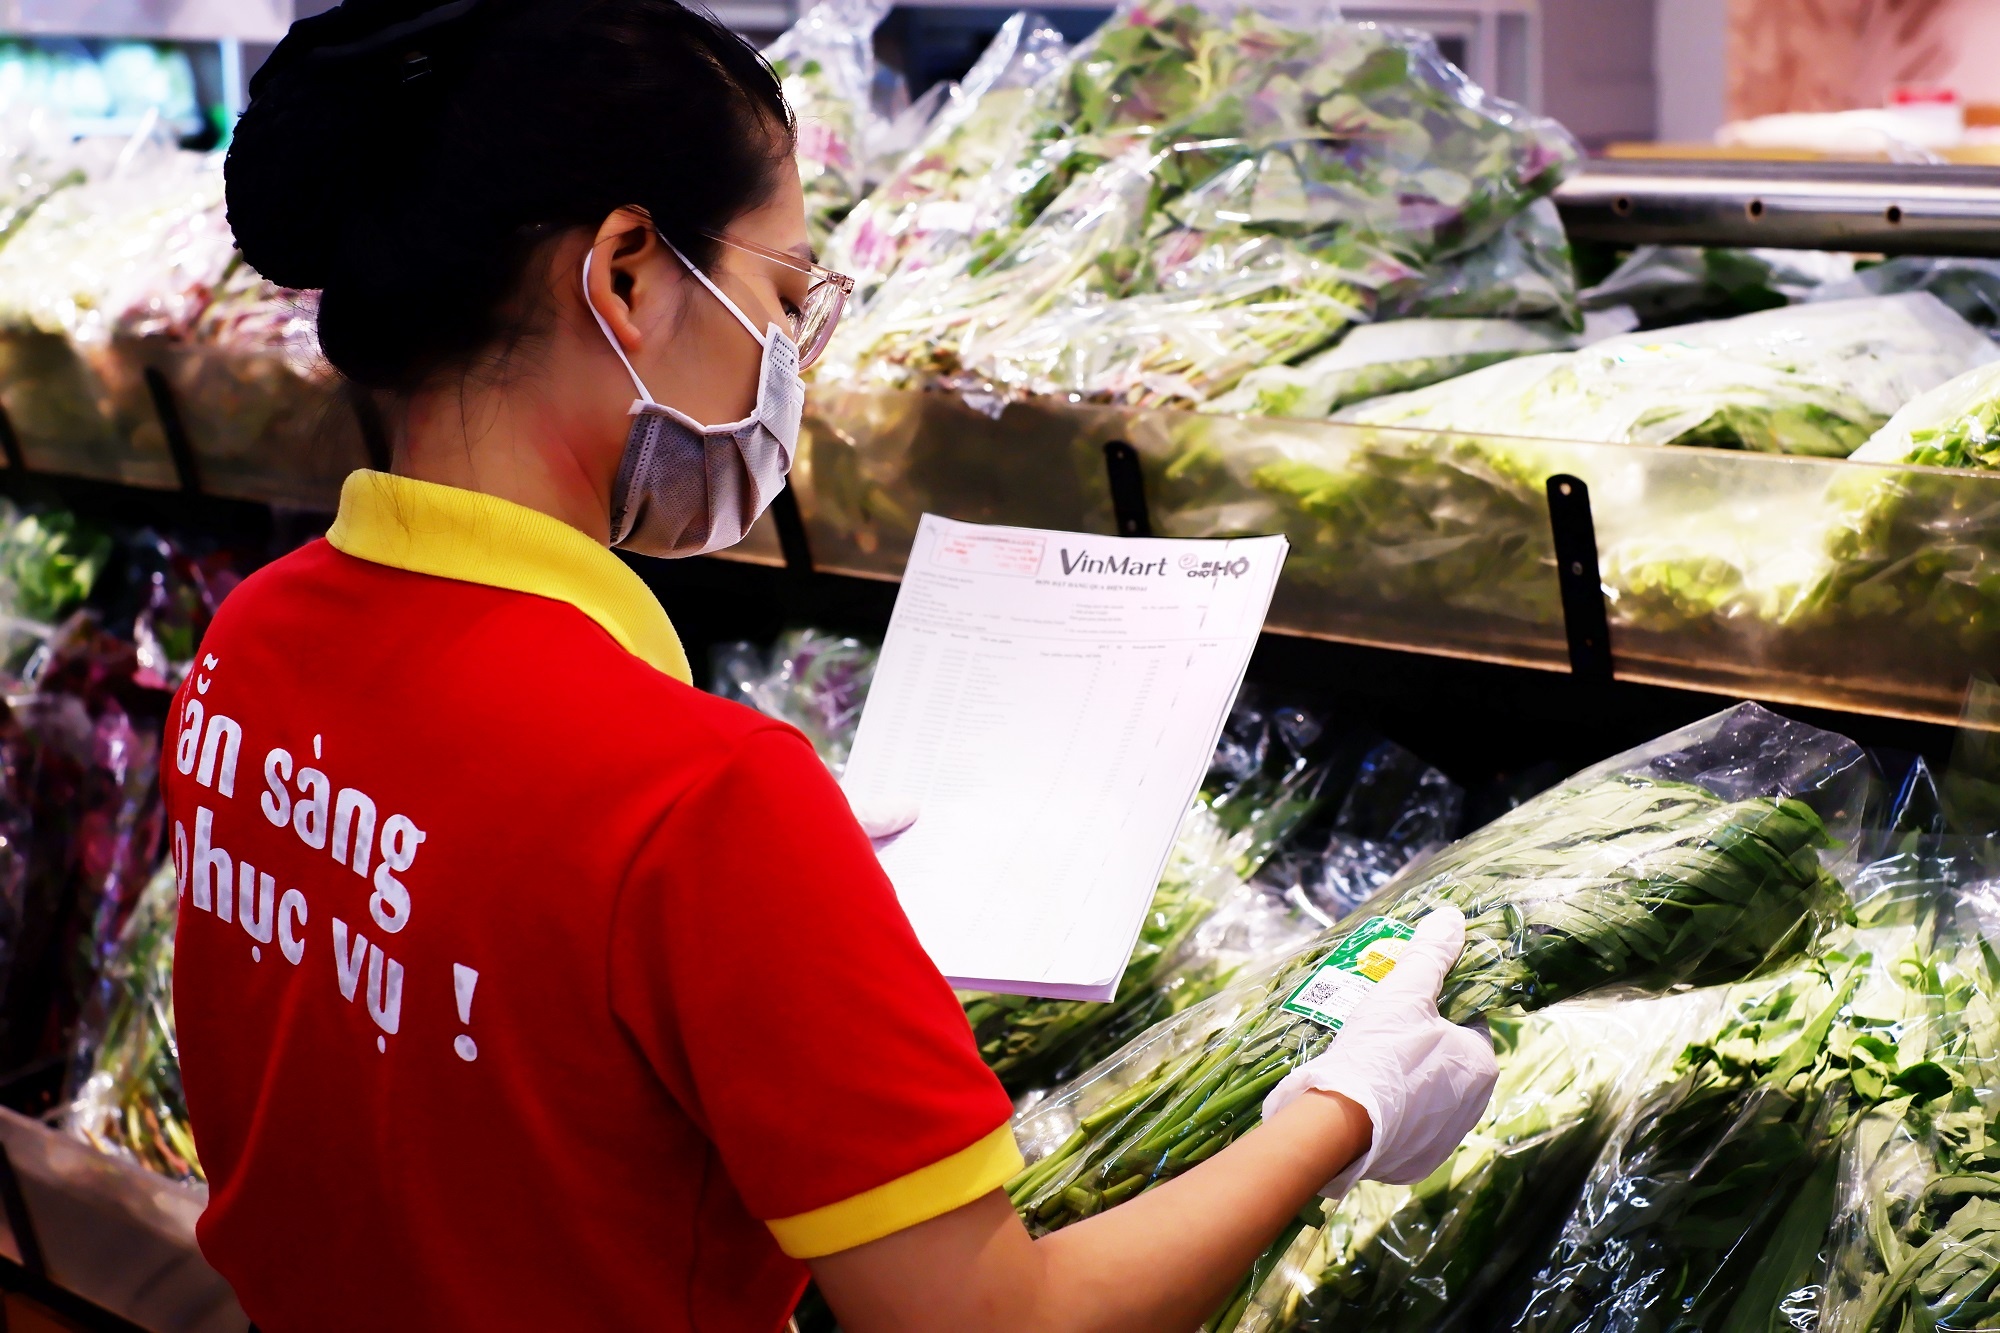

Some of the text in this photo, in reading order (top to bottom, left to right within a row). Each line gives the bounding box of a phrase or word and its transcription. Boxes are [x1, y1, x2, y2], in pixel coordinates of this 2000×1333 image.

[1060, 548, 1167, 576] VinMart
[176, 653, 242, 799] ẵn
[332, 917, 404, 1054] vụ
[453, 962, 479, 1062] !
